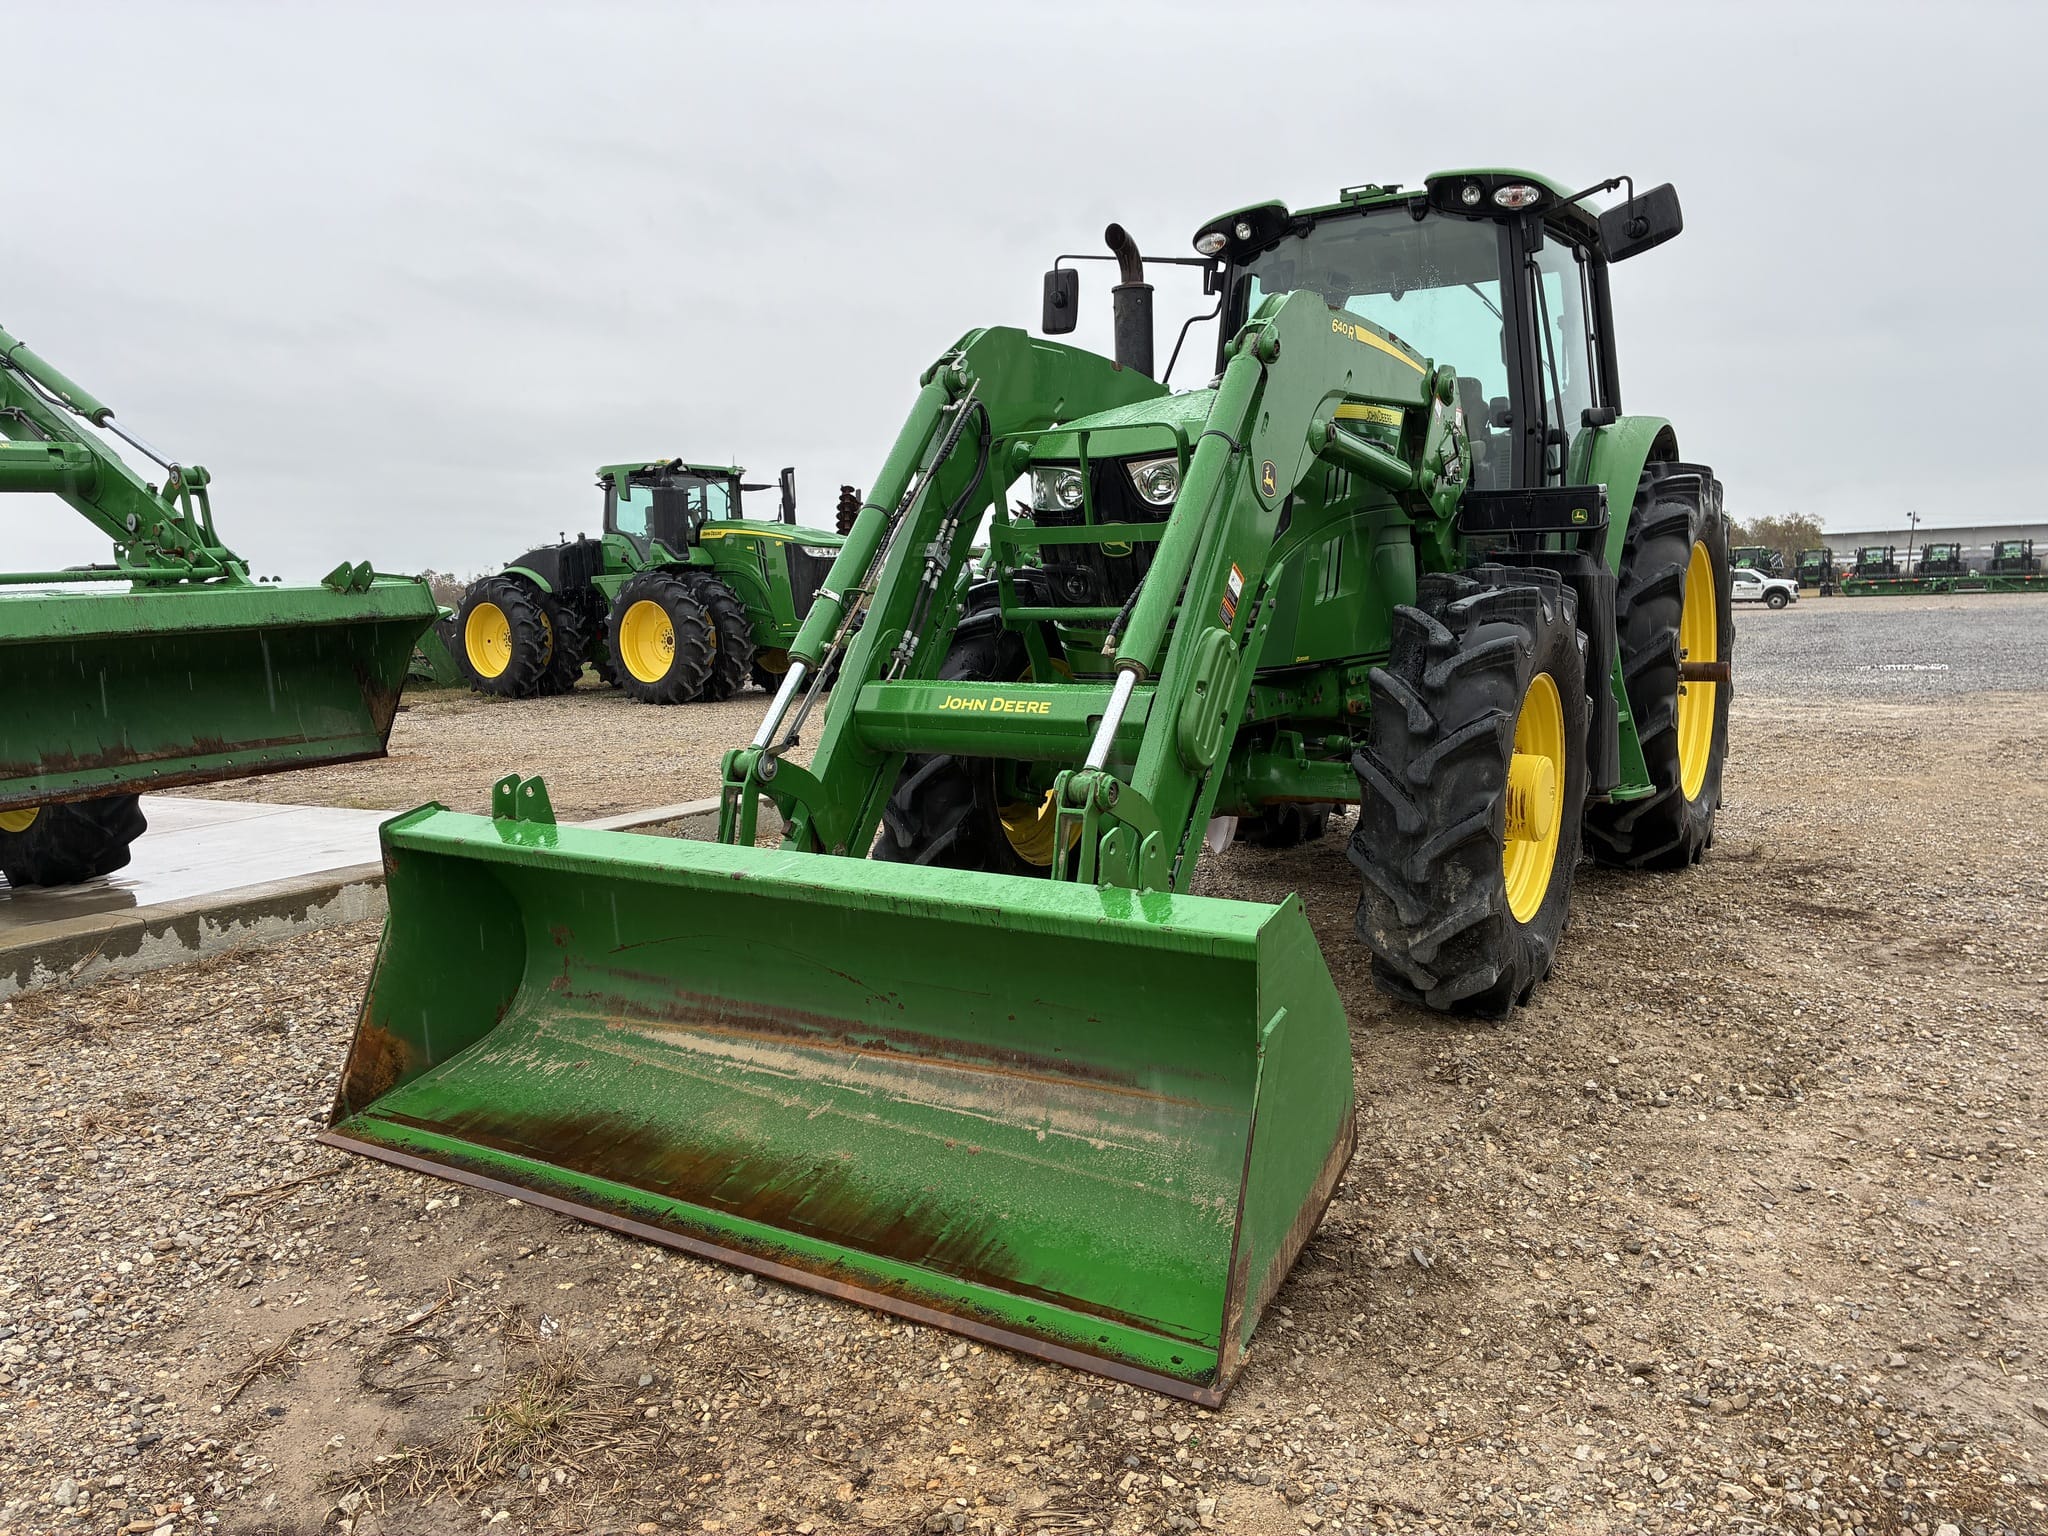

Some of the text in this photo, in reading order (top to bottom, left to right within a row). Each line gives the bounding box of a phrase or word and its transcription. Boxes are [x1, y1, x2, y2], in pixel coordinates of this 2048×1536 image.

[1332, 318, 1355, 340] 640R
[938, 695, 1052, 714] JOHN DEERE
